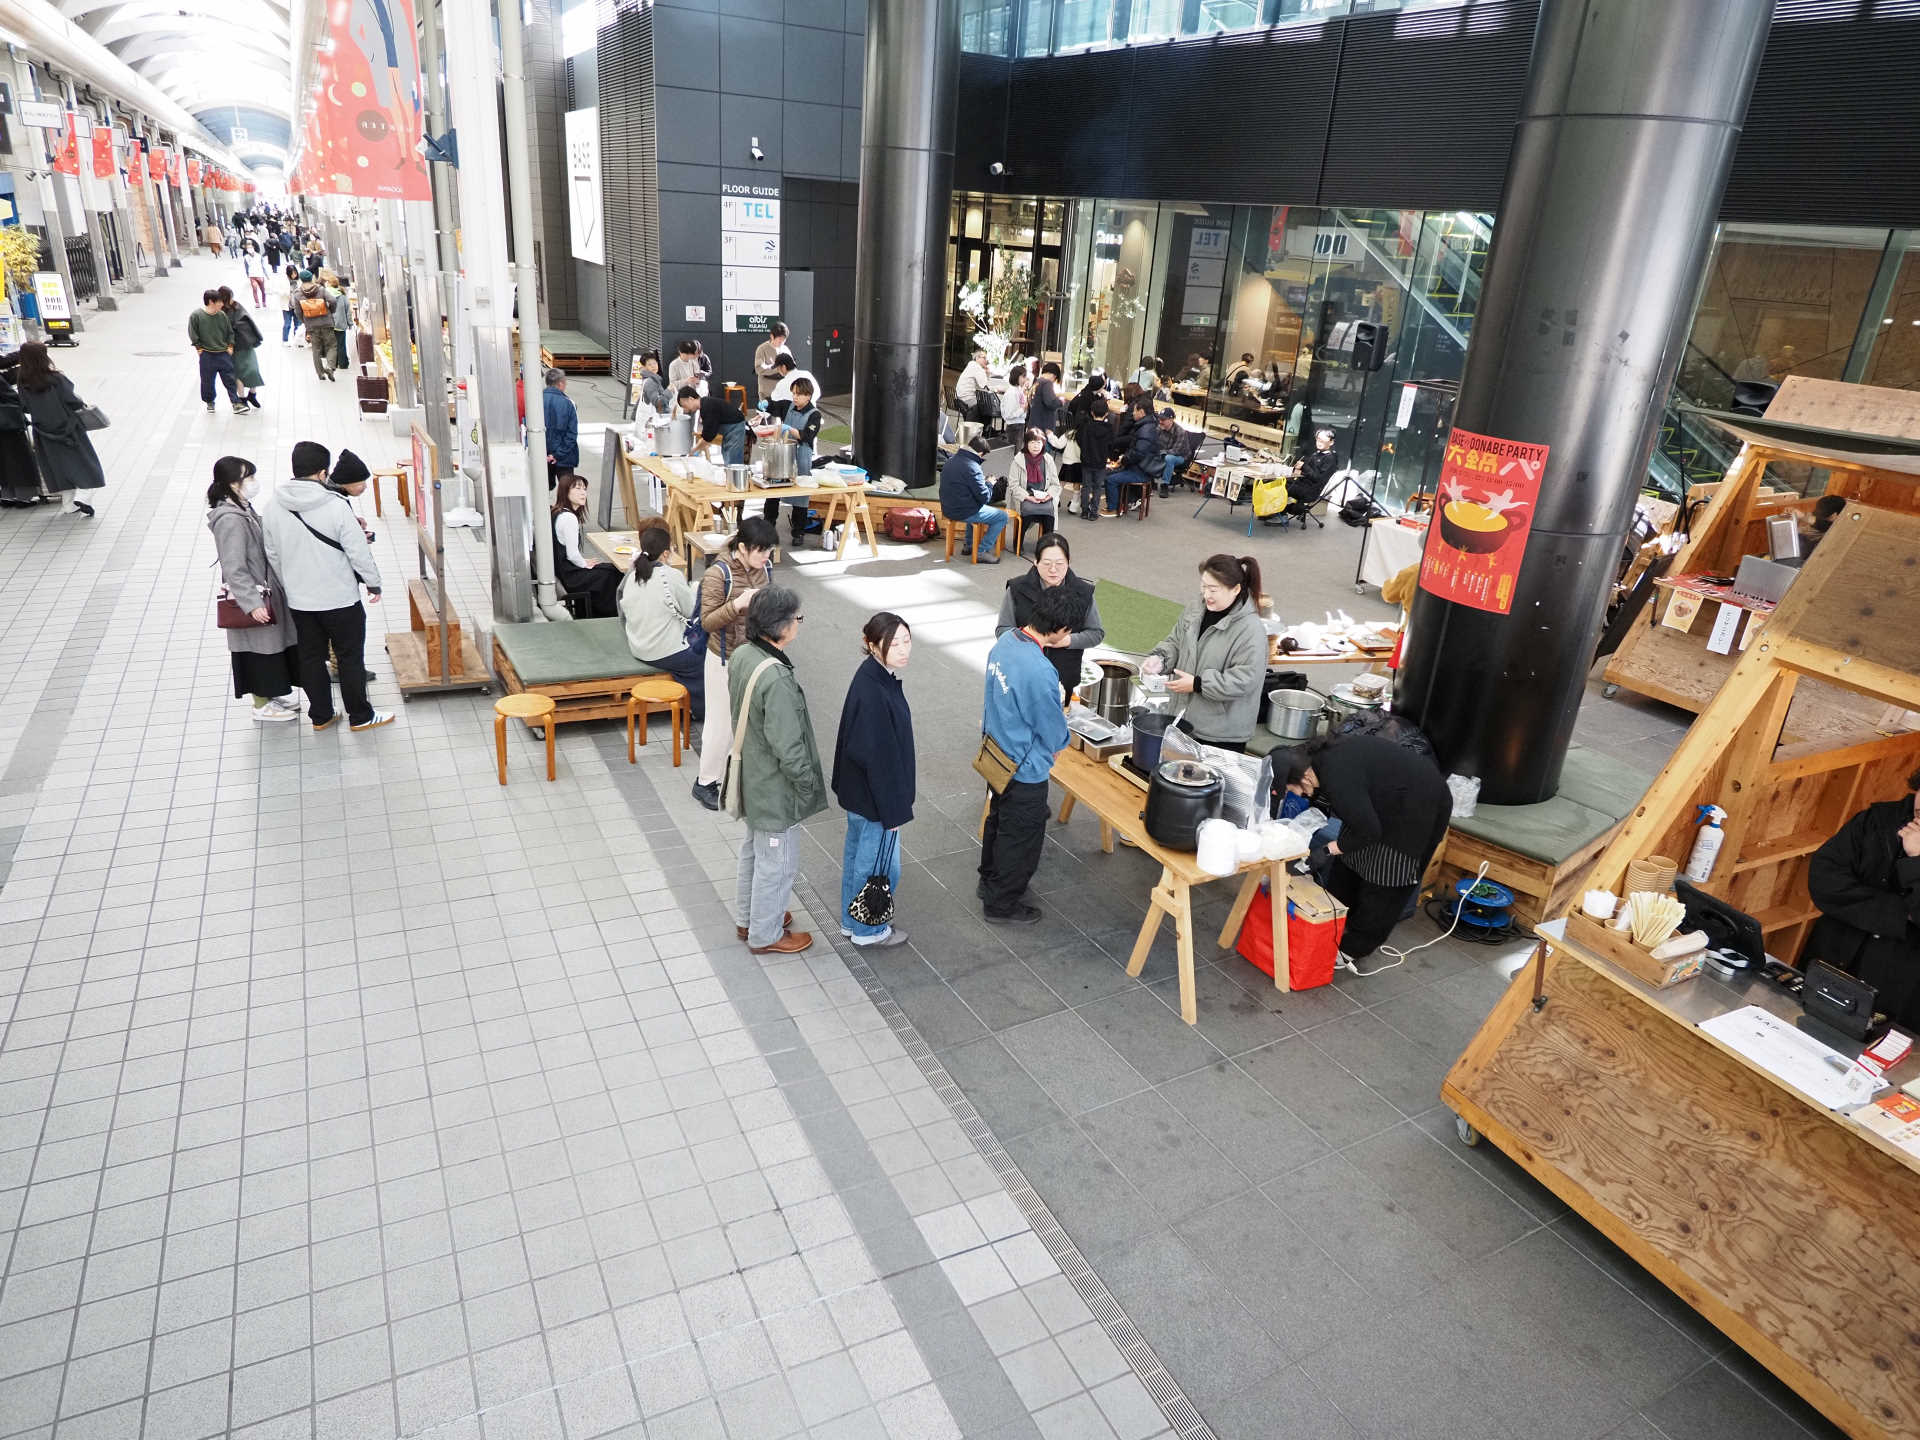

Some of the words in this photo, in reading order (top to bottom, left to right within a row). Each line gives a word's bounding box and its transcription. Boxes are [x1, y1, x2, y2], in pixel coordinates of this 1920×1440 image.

[722, 183, 750, 194] FLOOR
[752, 186, 780, 197] GUIDE
[743, 202, 774, 219] TEL
[749, 315, 768, 323] albis
[1506, 445, 1545, 461] PARTY
